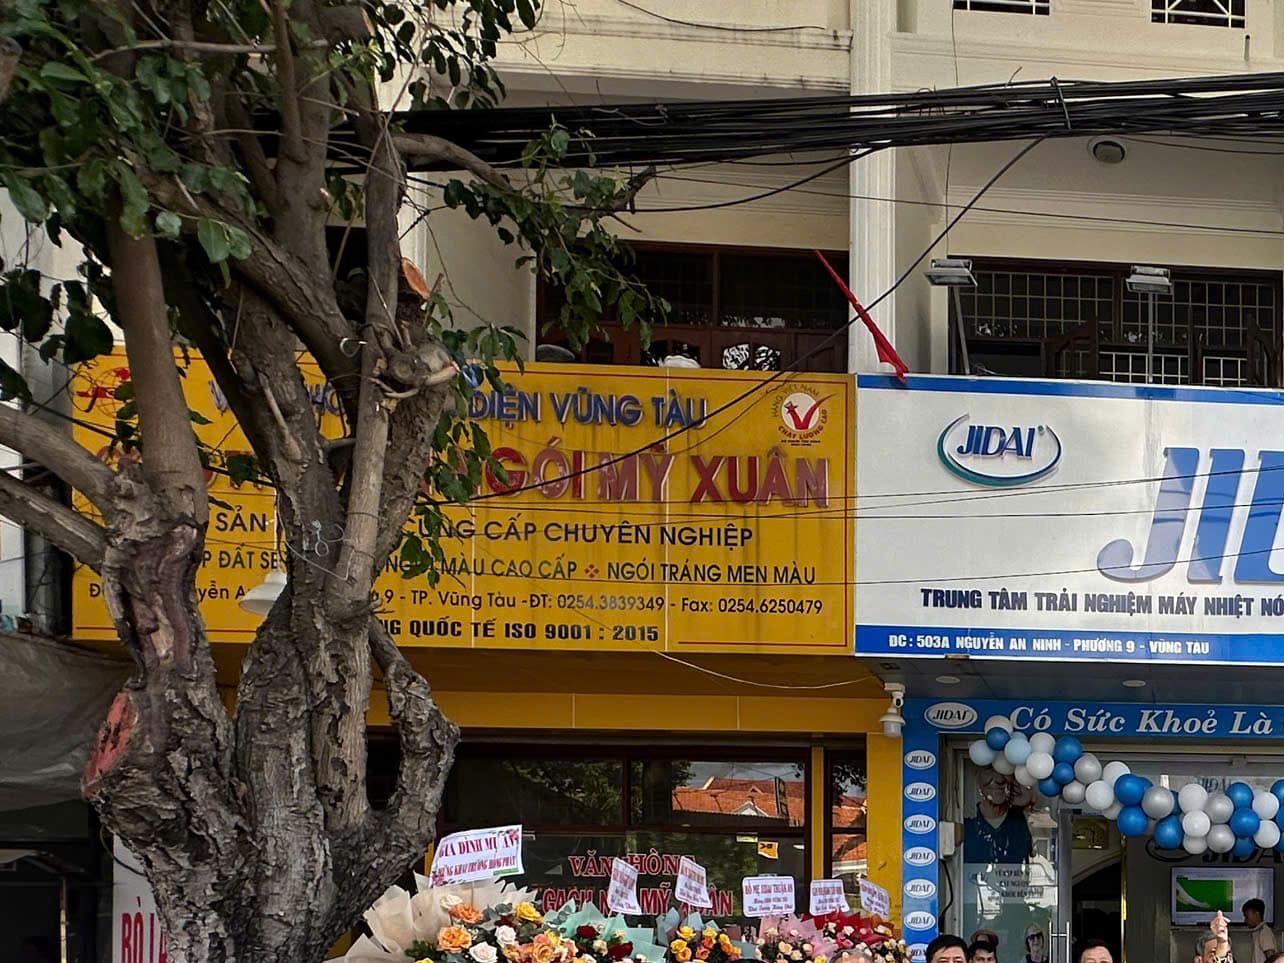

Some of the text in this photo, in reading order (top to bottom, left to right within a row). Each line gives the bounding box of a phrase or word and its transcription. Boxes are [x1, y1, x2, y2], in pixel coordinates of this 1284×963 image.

[550, 388, 644, 429] VŨNG
[652, 388, 707, 430] TÀU
[956, 424, 1037, 459] JIDAI
[690, 446, 830, 507] XUÂN
[215, 505, 267, 533] SẢN
[484, 513, 753, 551] CẤP CHUYÊN NGHIỆP
[218, 547, 254, 569] ĐẤT
[491, 558, 533, 579] CAO
[538, 553, 578, 579] CẤP
[607, 557, 816, 585] NGÓI TRÁNG MEN MÀU
[438, 590, 482, 611] Vũng
[487, 590, 517, 608] Tàu
[557, 593, 665, 611] 0254.3839349
[681, 596, 713, 613] Fax:
[718, 597, 824, 615] 0254.6250479
[921, 588, 983, 610] TRUNG
[988, 587, 1028, 611] TÂM
[1034, 587, 1077, 612] TRẢI
[1084, 589, 1153, 617] NGHIỆM
[1158, 591, 1199, 616] MÁY
[1204, 593, 1254, 620] NHIỆT
[409, 614, 462, 638] QUỐC
[470, 614, 496, 639] TẾ
[505, 621, 537, 640] ISO
[545, 623, 591, 641] 9001
[612, 624, 659, 642] 2015
[916, 634, 951, 649] 503A
[956, 631, 1004, 650] NGUYỄN
[1009, 638, 1027, 651] AN
[1032, 638, 1062, 652] NINH
[1126, 639, 1136, 653] 9
[1010, 706, 1052, 731] Có
[1064, 708, 1127, 733] Sức
[1136, 709, 1218, 735] Khoẻ
[1229, 711, 1274, 736] Là
